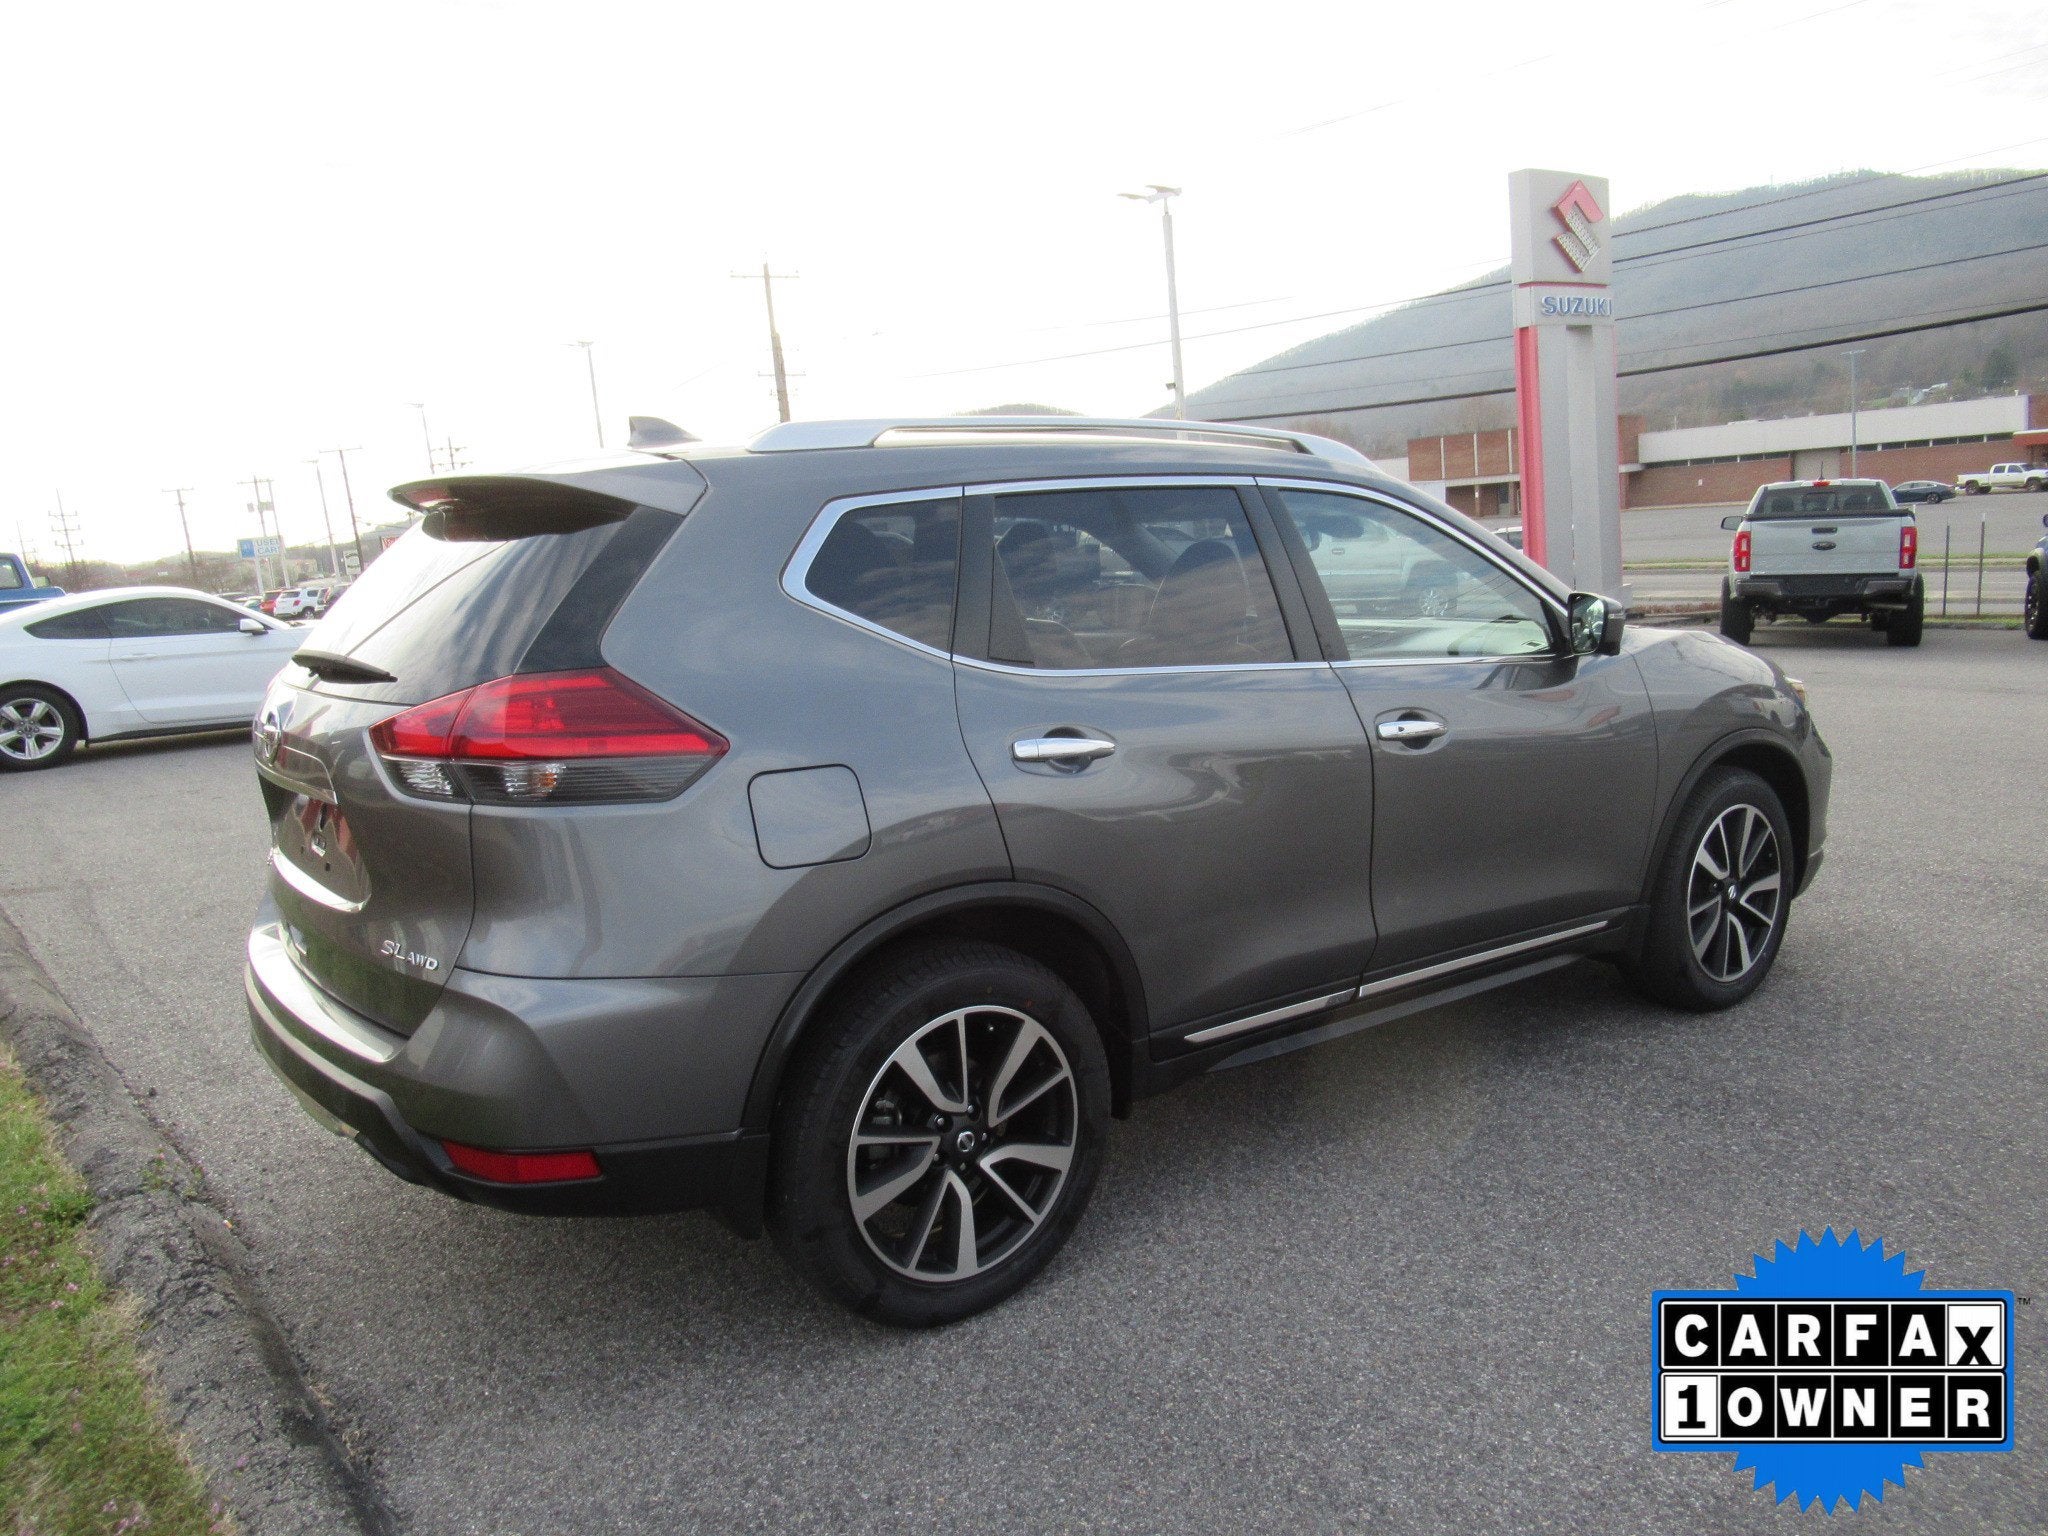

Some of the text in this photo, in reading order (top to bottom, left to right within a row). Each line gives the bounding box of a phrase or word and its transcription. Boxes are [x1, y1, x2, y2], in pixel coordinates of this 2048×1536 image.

[1542, 296, 1612, 316] SUZUKI
[257, 546, 280, 555] CAR
[408, 951, 439, 971] AWD
